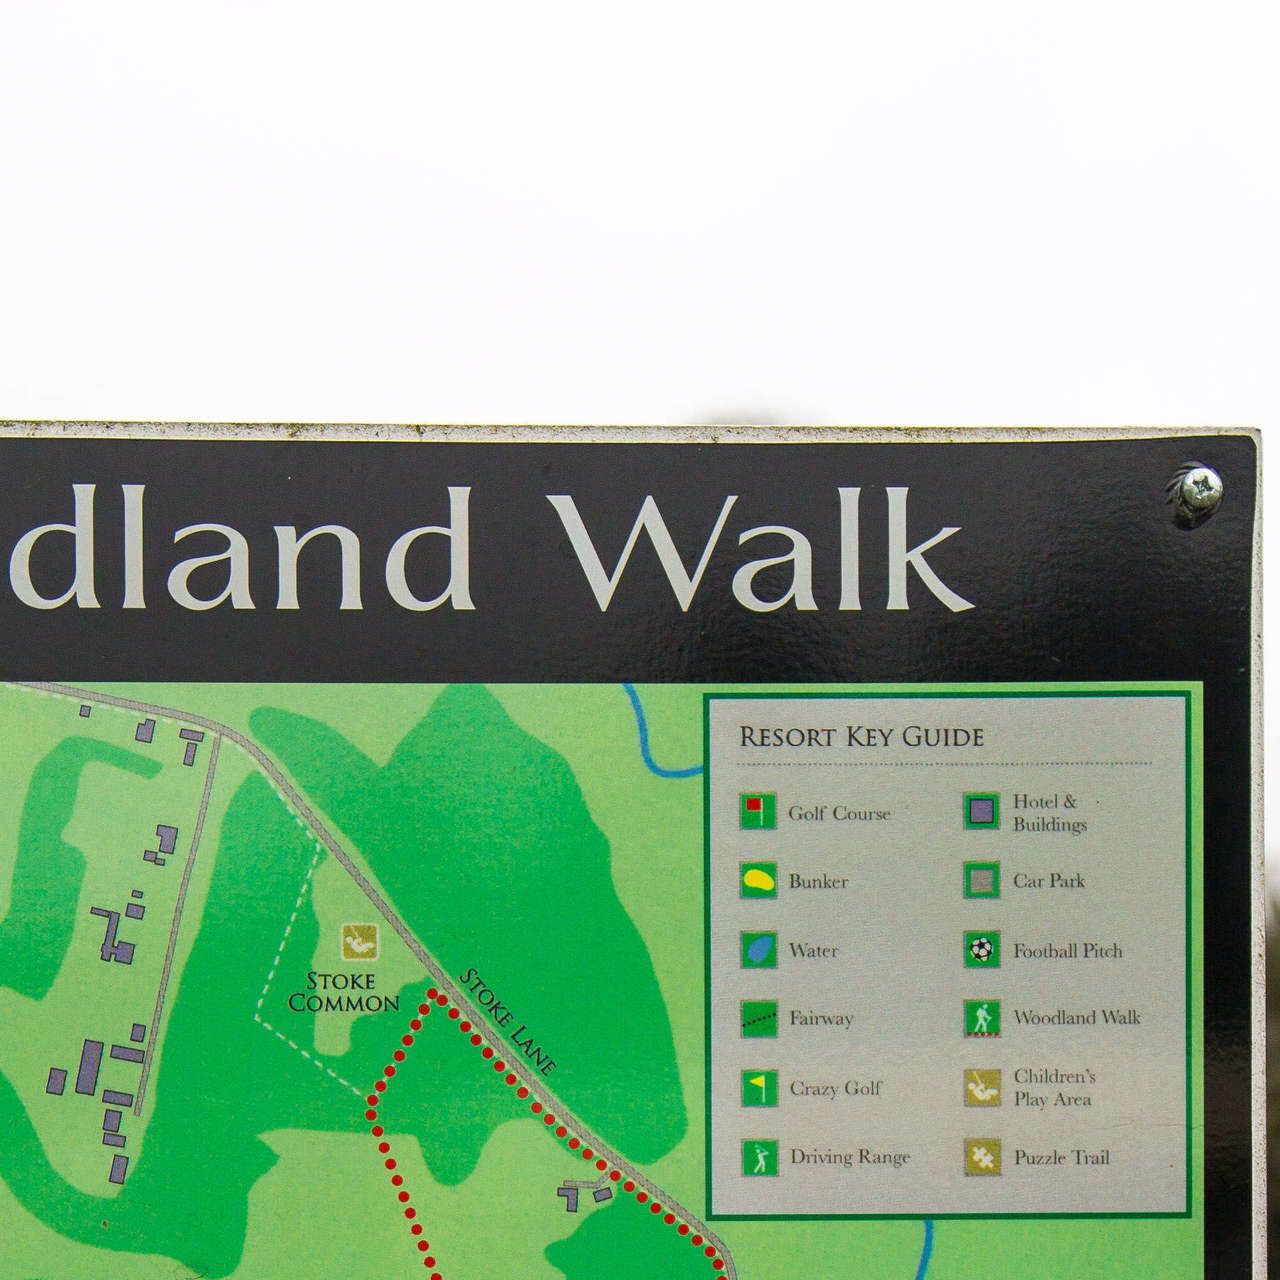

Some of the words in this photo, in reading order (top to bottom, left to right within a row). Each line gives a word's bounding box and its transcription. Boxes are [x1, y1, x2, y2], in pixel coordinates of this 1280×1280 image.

[546, 487, 975, 612] Walk
[741, 726, 836, 746] RESORT
[847, 726, 894, 746] KEY
[903, 726, 984, 746] GUIDE
[1015, 794, 1057, 808] Hotel
[1064, 795, 1075, 808] &
[788, 805, 826, 821] Golf
[833, 805, 890, 822] Course
[1015, 817, 1087, 834] Buildings
[790, 874, 849, 889] Bunker
[1014, 874, 1043, 888] Car
[1051, 873, 1084, 887] Park
[789, 943, 839, 958] Water
[1015, 944, 1077, 958] Football
[1084, 943, 1122, 958] Pitch
[307, 972, 374, 990] STOKE
[289, 993, 399, 1012] COMMON
[460, 968, 514, 1027] STOKE
[511, 1025, 556, 1076] LANE
[790, 1011, 854, 1030] Fairway
[1015, 1010, 1095, 1024] Woodland
[1102, 1010, 1140, 1024] Walk
[1015, 1069, 1095, 1083] Children's
[790, 1081, 838, 1099] Crazy
[845, 1080, 883, 1096] Golf
[1014, 1092, 1048, 1110] Play
[1054, 1092, 1092, 1107] Area
[792, 1149, 852, 1166] Driving
[859, 1149, 911, 1168] Range
[1015, 1150, 1066, 1166] Puzzle
[1072, 1150, 1110, 1166] Trail
